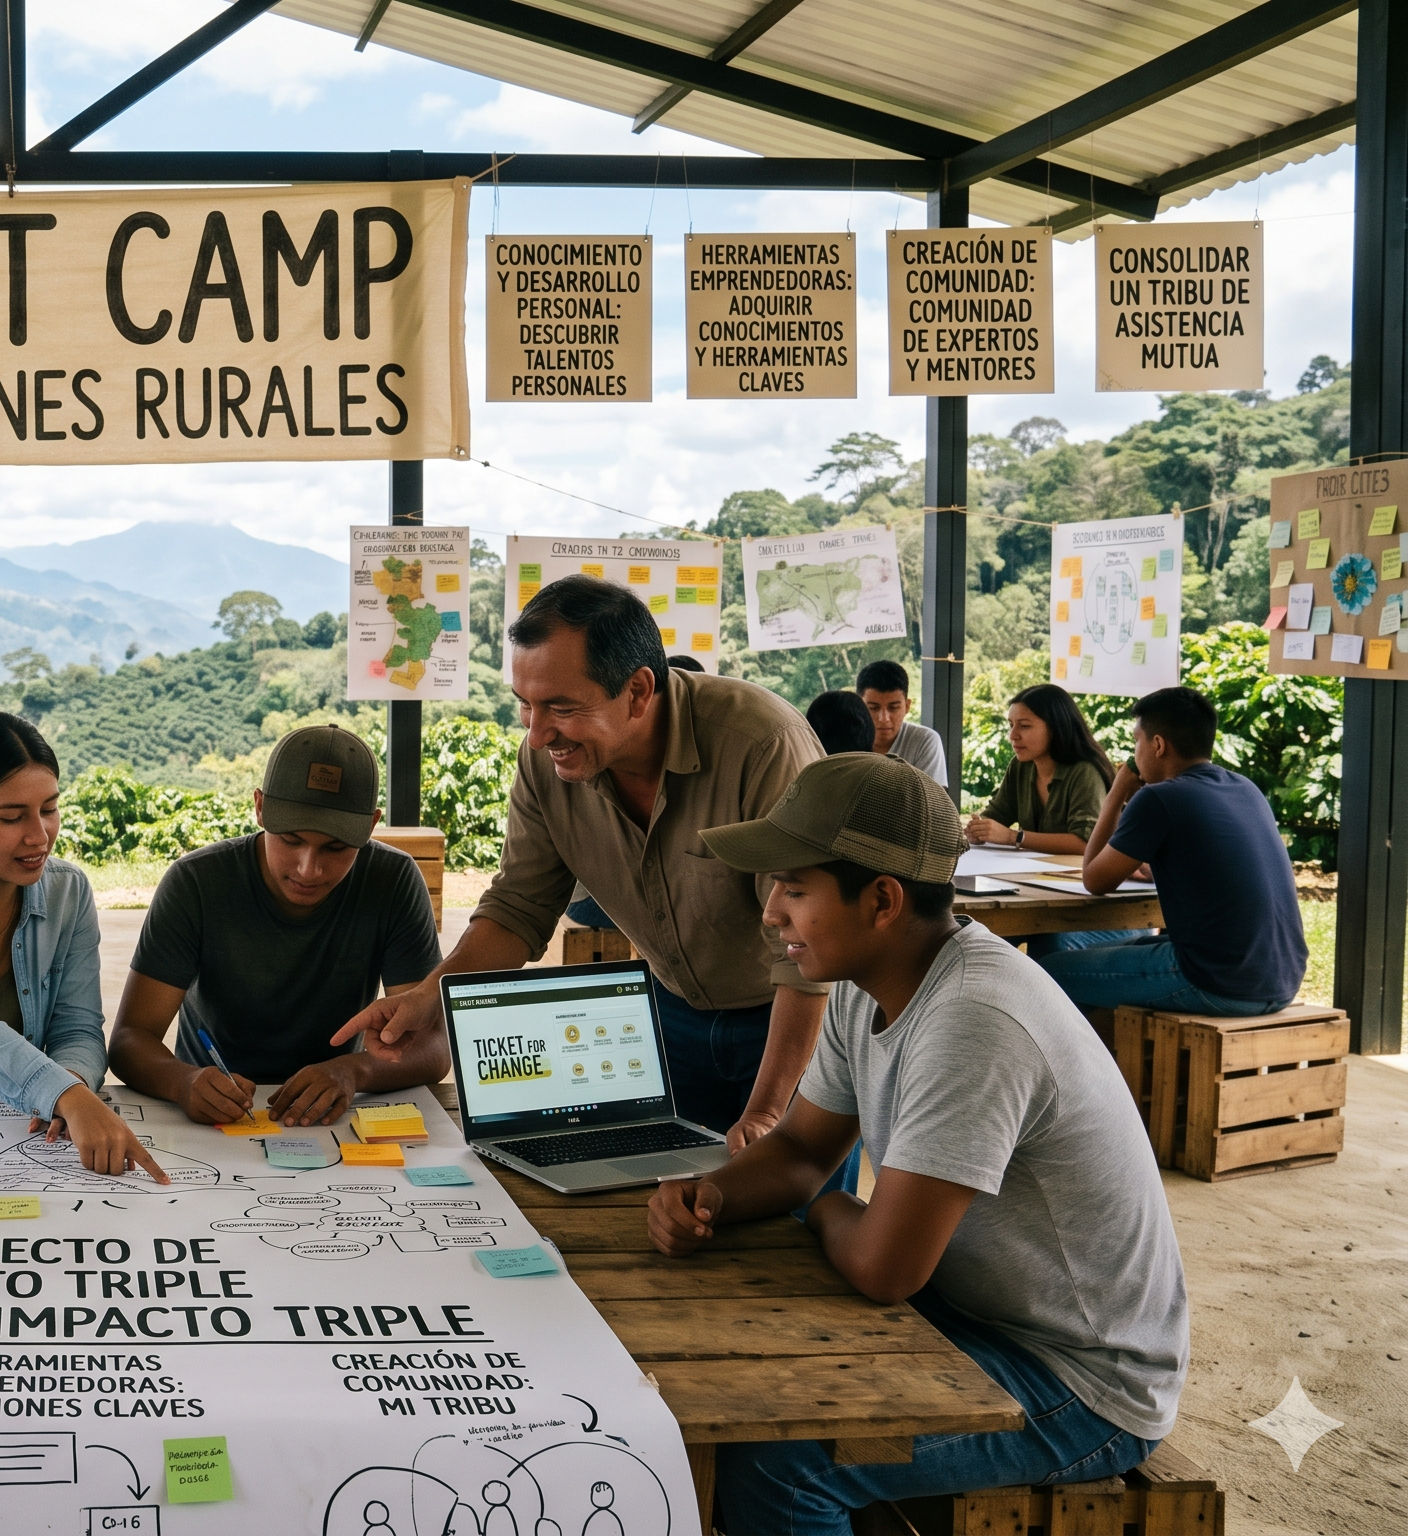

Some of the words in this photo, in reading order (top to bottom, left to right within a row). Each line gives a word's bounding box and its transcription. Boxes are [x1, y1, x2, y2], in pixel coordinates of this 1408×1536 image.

[496, 243, 643, 267] CONOCIMIENTO
[701, 243, 840, 266] HERRAMIENTAS
[902, 233, 1004, 265] CREACIÓN
[1011, 239, 1038, 264] DE
[1109, 246, 1250, 274] CONSOLIDAR
[105, 206, 414, 346] CAMP
[496, 270, 511, 293] Y
[516, 270, 640, 294] DESARROLLO
[690, 269, 852, 291] EMPRENDEDORAS:
[906, 268, 1035, 294] COMUNIDAD:
[1110, 279, 1140, 307] UN
[1147, 278, 1214, 306] TRIBU
[1222, 278, 1250, 305] DE
[517, 297, 622, 320] PERSONAL:
[728, 295, 813, 319] ADQUIRIR
[909, 298, 1032, 324] COMUNIDAD
[519, 323, 620, 345] DESCUBRIR
[698, 320, 844, 342] CONOCIMIENTOS
[1115, 310, 1245, 338] ASISTENCIA
[903, 329, 930, 353] DE
[936, 327, 1039, 353] EXPERTOS
[523, 349, 615, 371] TALENTOS
[694, 346, 707, 367] Y
[712, 345, 848, 367] HERRAMIENTAS
[1141, 342, 1219, 369] MUTUA
[905, 358, 920, 382] Y
[927, 356, 1036, 382] MENTORES
[512, 375, 627, 396] PERSONALES
[738, 371, 805, 393] CLAVES
[135, 362, 409, 440] RURALES
[473, 1035, 525, 1058] TICKET
[528, 1040, 546, 1054] FOR
[477, 1055, 543, 1080] CHANGE
[153, 1238, 221, 1264] DE
[63, 1270, 254, 1299] TRIPLE
[273, 1305, 485, 1337] TRIPLE
[331, 1348, 477, 1371] CREACIÓN
[484, 1352, 526, 1369] DE
[343, 1374, 534, 1392] COMUNIDAD:
[93, 1398, 205, 1418] CLAVES
[378, 1397, 416, 1416] MI
[422, 1396, 516, 1416] TRIBU
